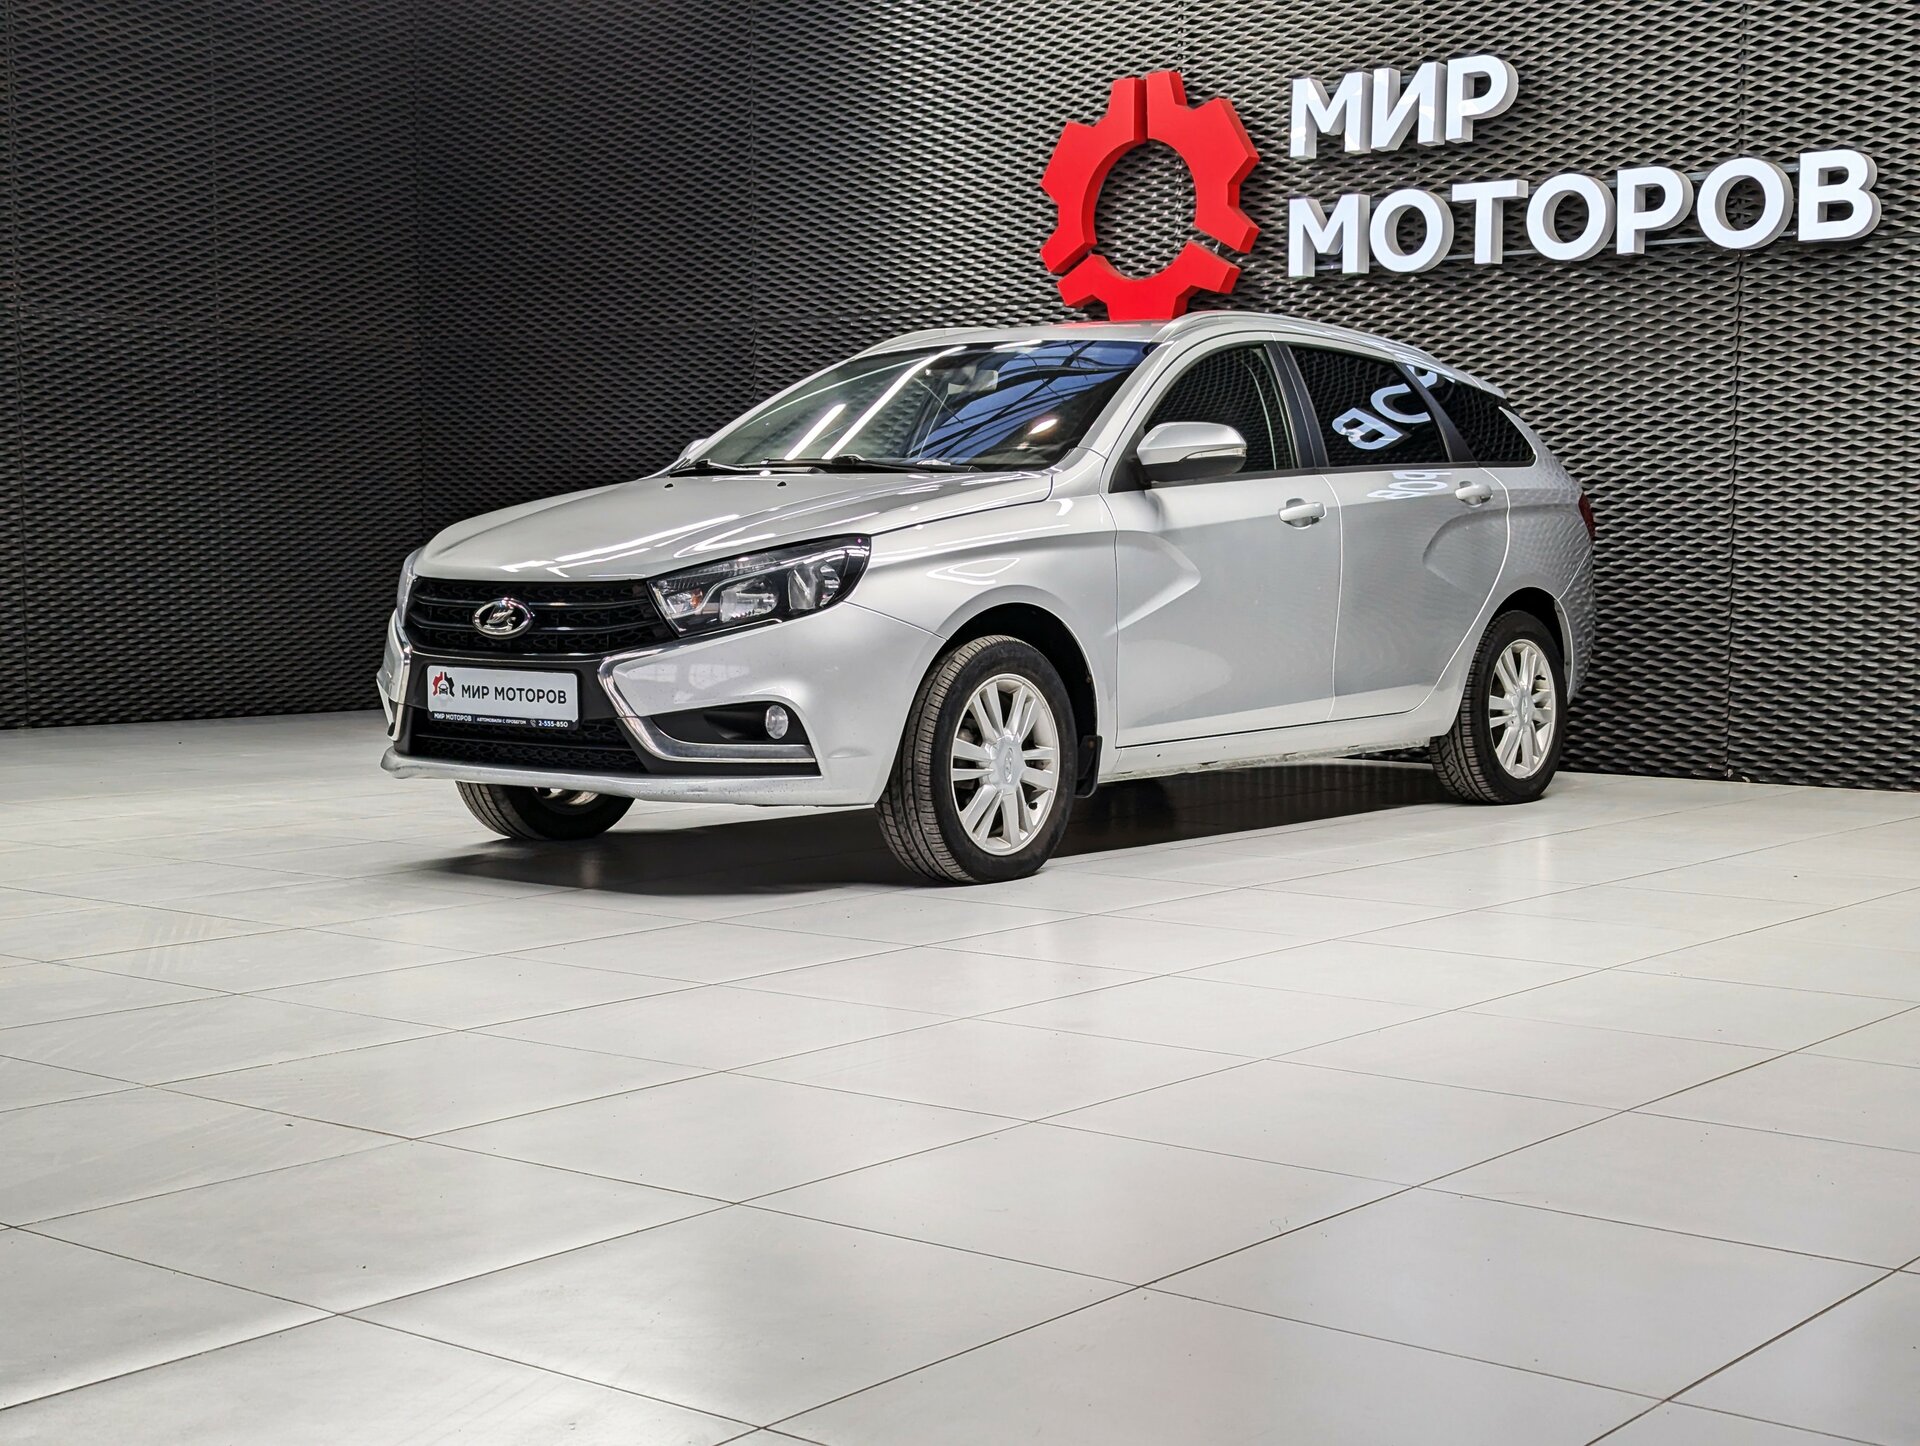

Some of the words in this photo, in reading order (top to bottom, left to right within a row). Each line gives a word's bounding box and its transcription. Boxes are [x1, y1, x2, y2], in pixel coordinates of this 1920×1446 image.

[1289, 54, 1518, 159] МИР
[1288, 150, 1881, 278] МОТОРОВ
[446, 713, 472, 722] МОТОРОВ
[461, 684, 489, 699] МИР
[494, 686, 567, 704] МОТОРОВ
